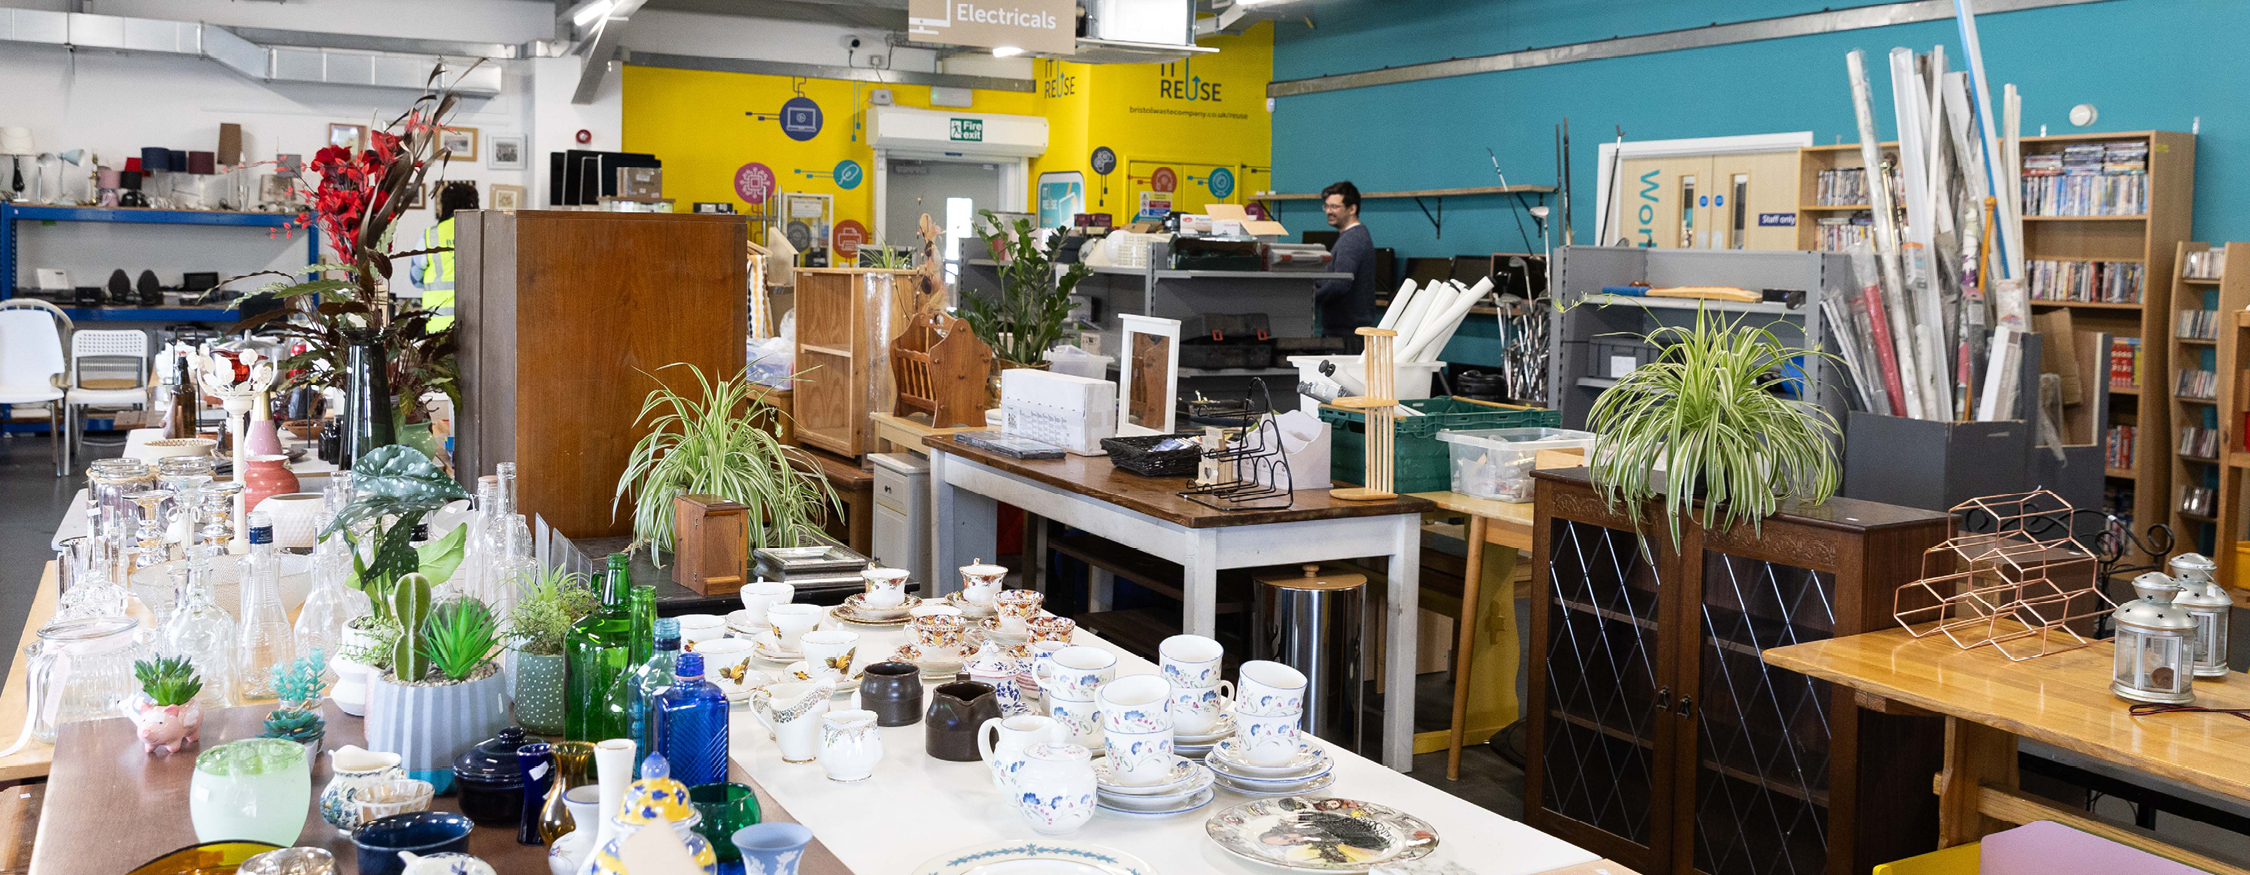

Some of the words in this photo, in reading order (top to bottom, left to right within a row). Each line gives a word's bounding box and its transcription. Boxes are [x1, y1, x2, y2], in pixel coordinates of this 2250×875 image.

[957, 3, 1057, 30] Electricals
[1044, 73, 1075, 99] REUSE
[1160, 76, 1222, 101] REUSE
[1129, 106, 1248, 119] bristolwastecompany.co.uk/reuse
[963, 121, 982, 131] Fire
[963, 130, 981, 139] exit
[1762, 215, 1779, 224] Staff
[1780, 215, 1796, 226] only
